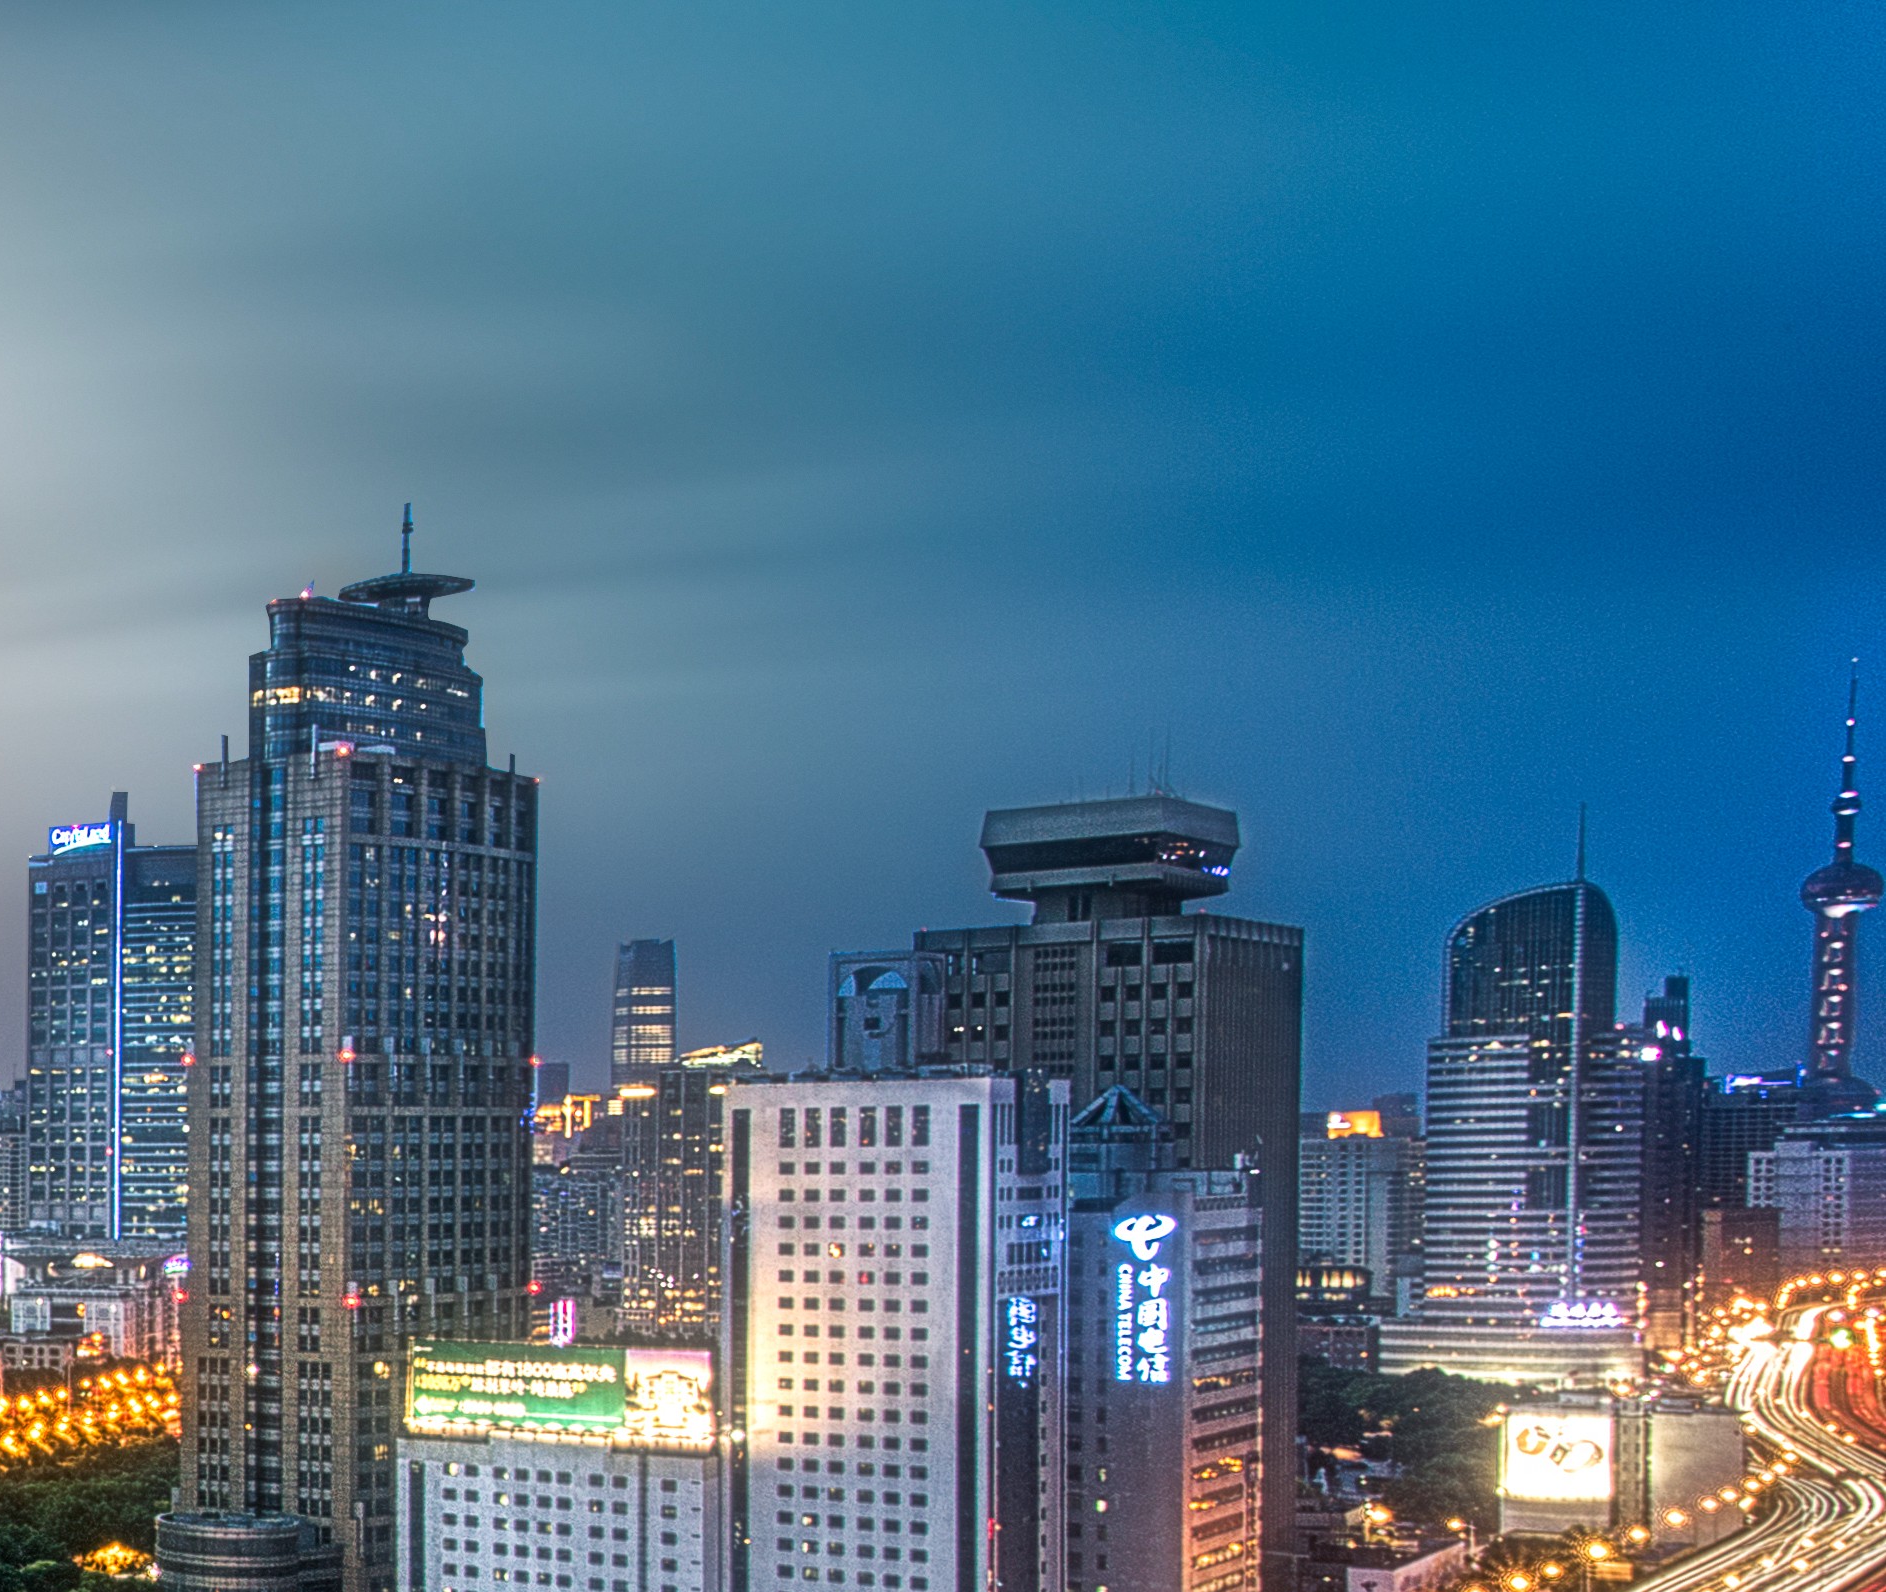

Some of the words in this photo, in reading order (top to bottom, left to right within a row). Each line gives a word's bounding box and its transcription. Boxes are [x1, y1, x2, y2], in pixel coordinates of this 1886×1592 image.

[1117, 1263, 1133, 1311] CHINA
[1117, 1312, 1133, 1381] TELECOM
[1137, 1263, 1171, 1383] 中国电信
